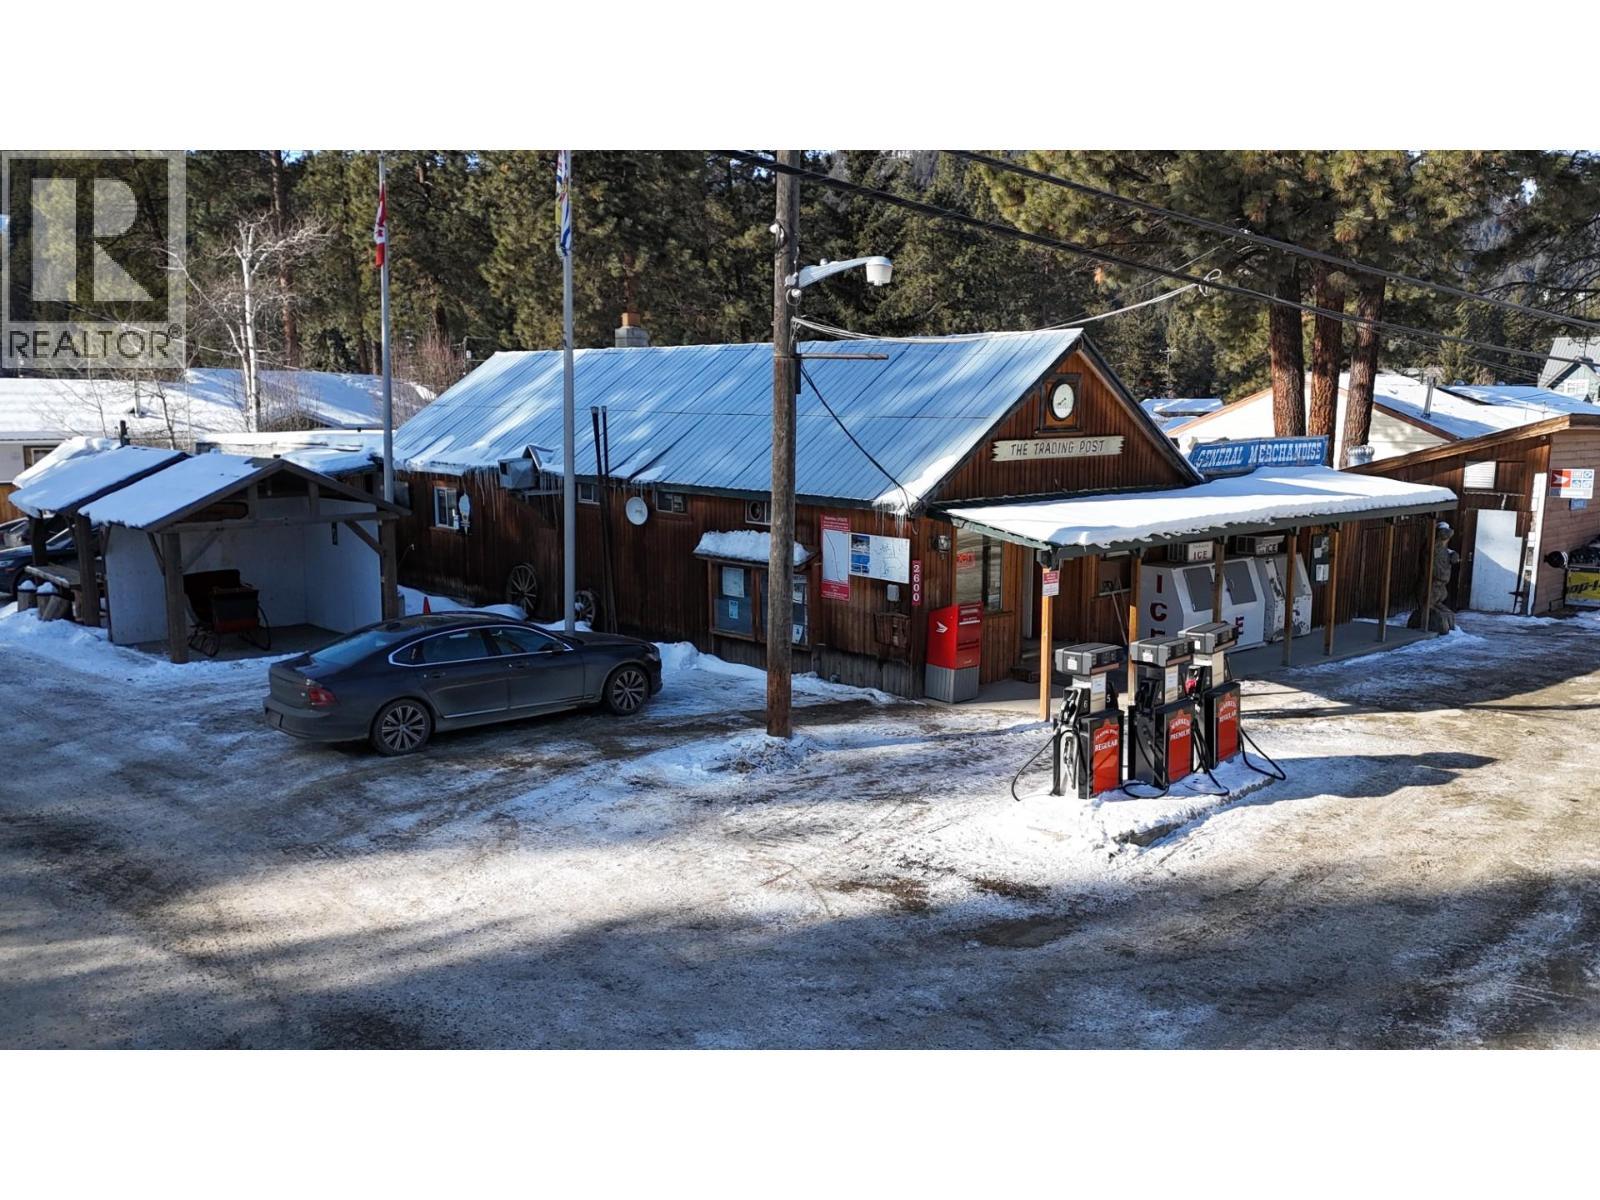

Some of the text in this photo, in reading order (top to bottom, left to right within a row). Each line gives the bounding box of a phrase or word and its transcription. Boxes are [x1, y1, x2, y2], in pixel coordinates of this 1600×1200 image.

[1011, 440, 1105, 456] THE TRADING POST
[1195, 442, 1322, 468] GENERAL MERCHANDISE
[1265, 543, 1278, 553] ICE
[1193, 550, 1208, 560] ICE
[912, 564, 920, 602] 2600
[1106, 694, 1111, 703] 5
[1095, 739, 1118, 750] REGULAR
